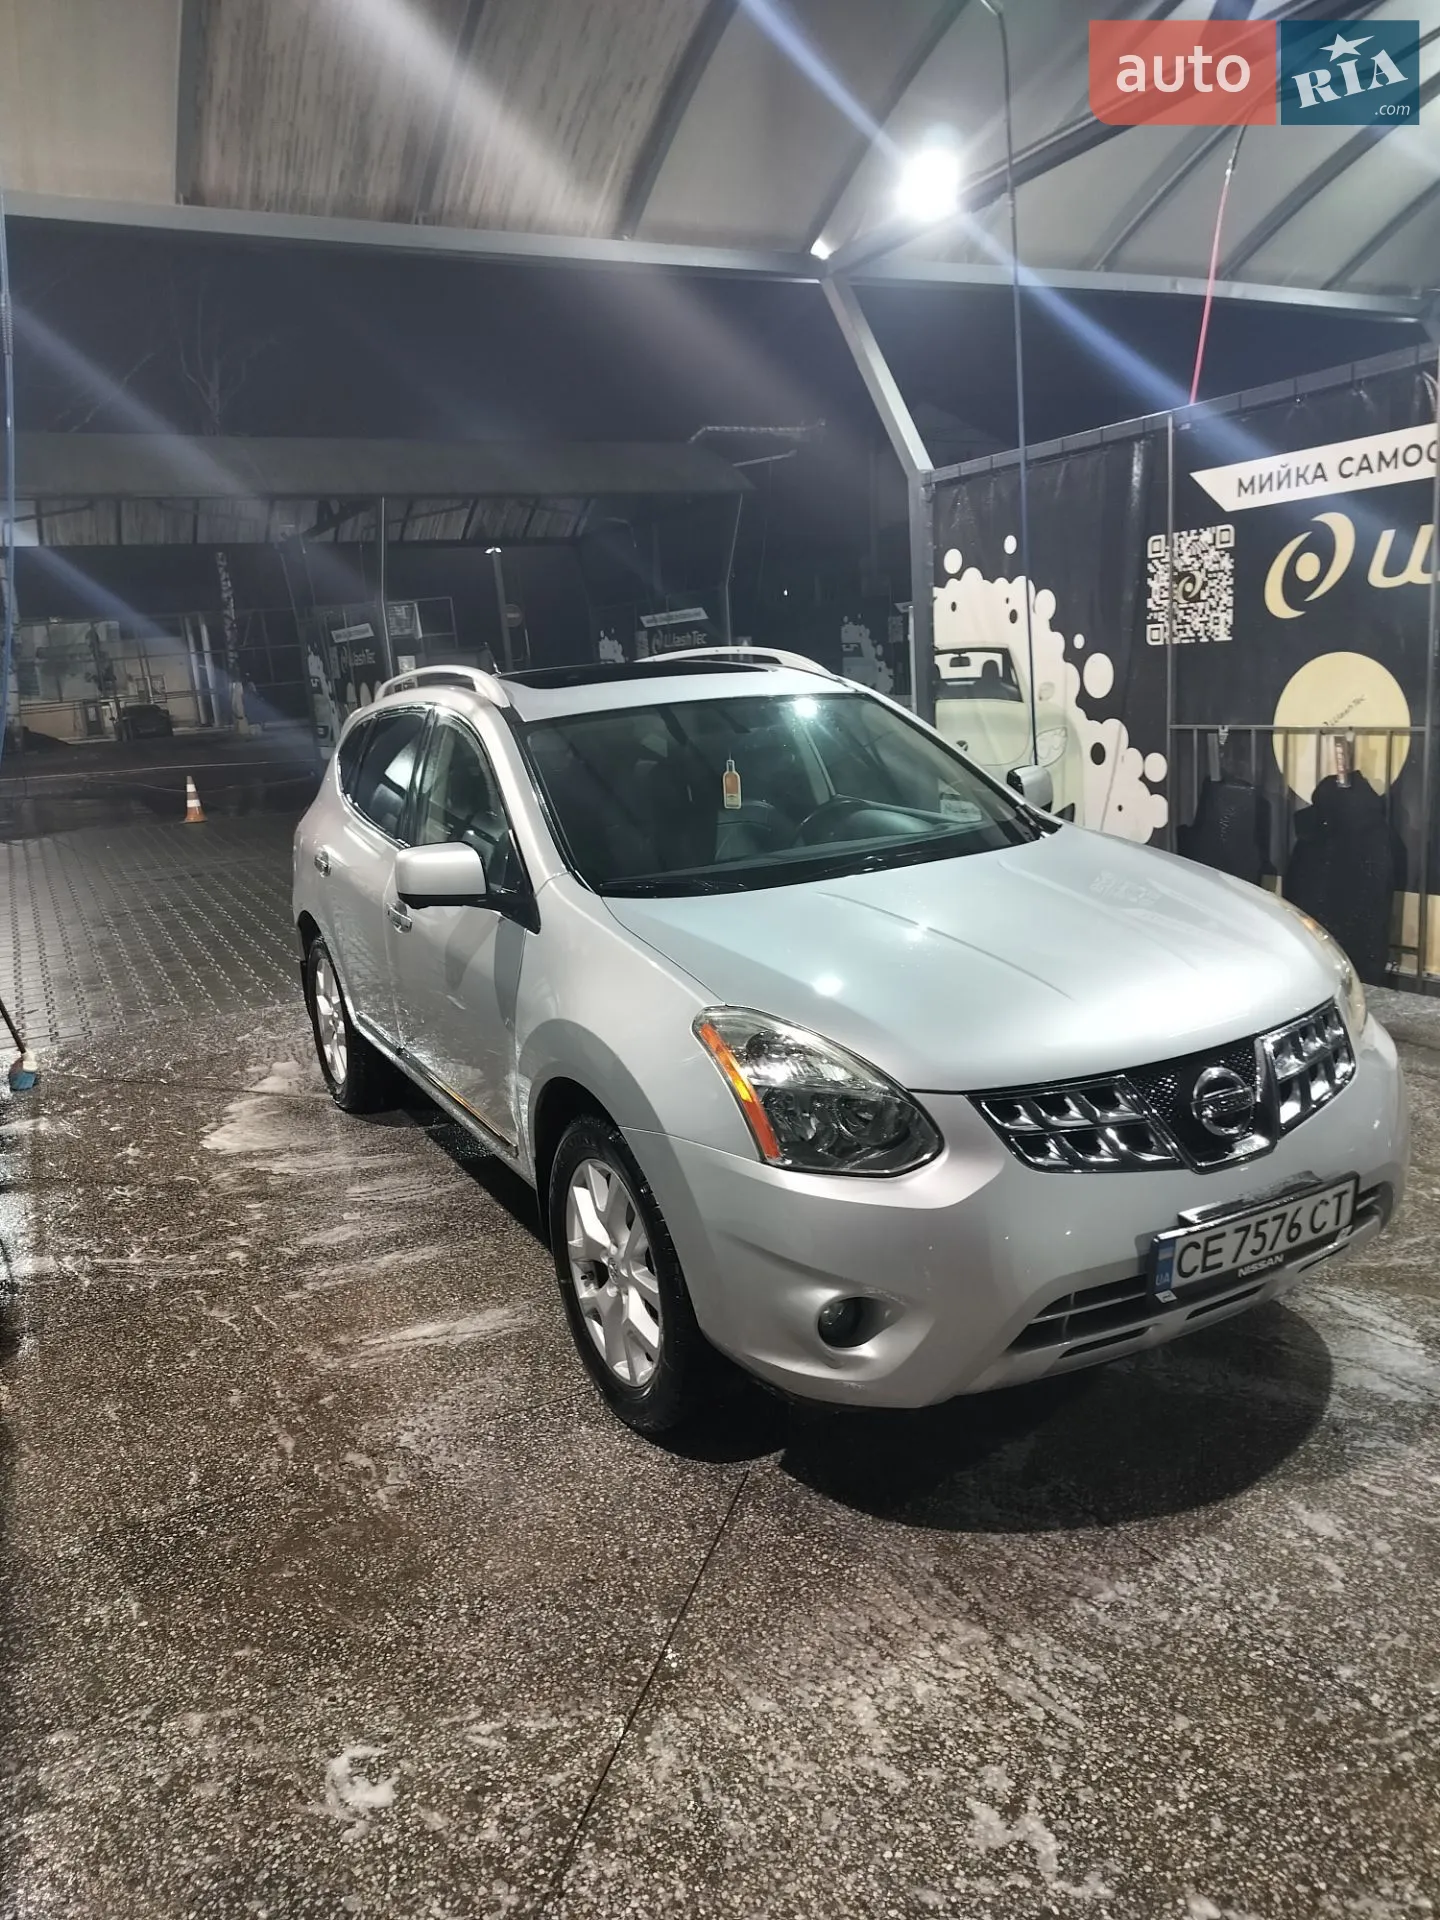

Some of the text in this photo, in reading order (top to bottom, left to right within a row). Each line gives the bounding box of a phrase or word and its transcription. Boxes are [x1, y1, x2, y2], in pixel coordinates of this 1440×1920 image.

[1238, 463, 1327, 497] МИЙКА
[1178, 1190, 1349, 1278] CE 7576 CT
[1155, 1272, 1170, 1286] UA
[1238, 1254, 1284, 1277] NISSAN
